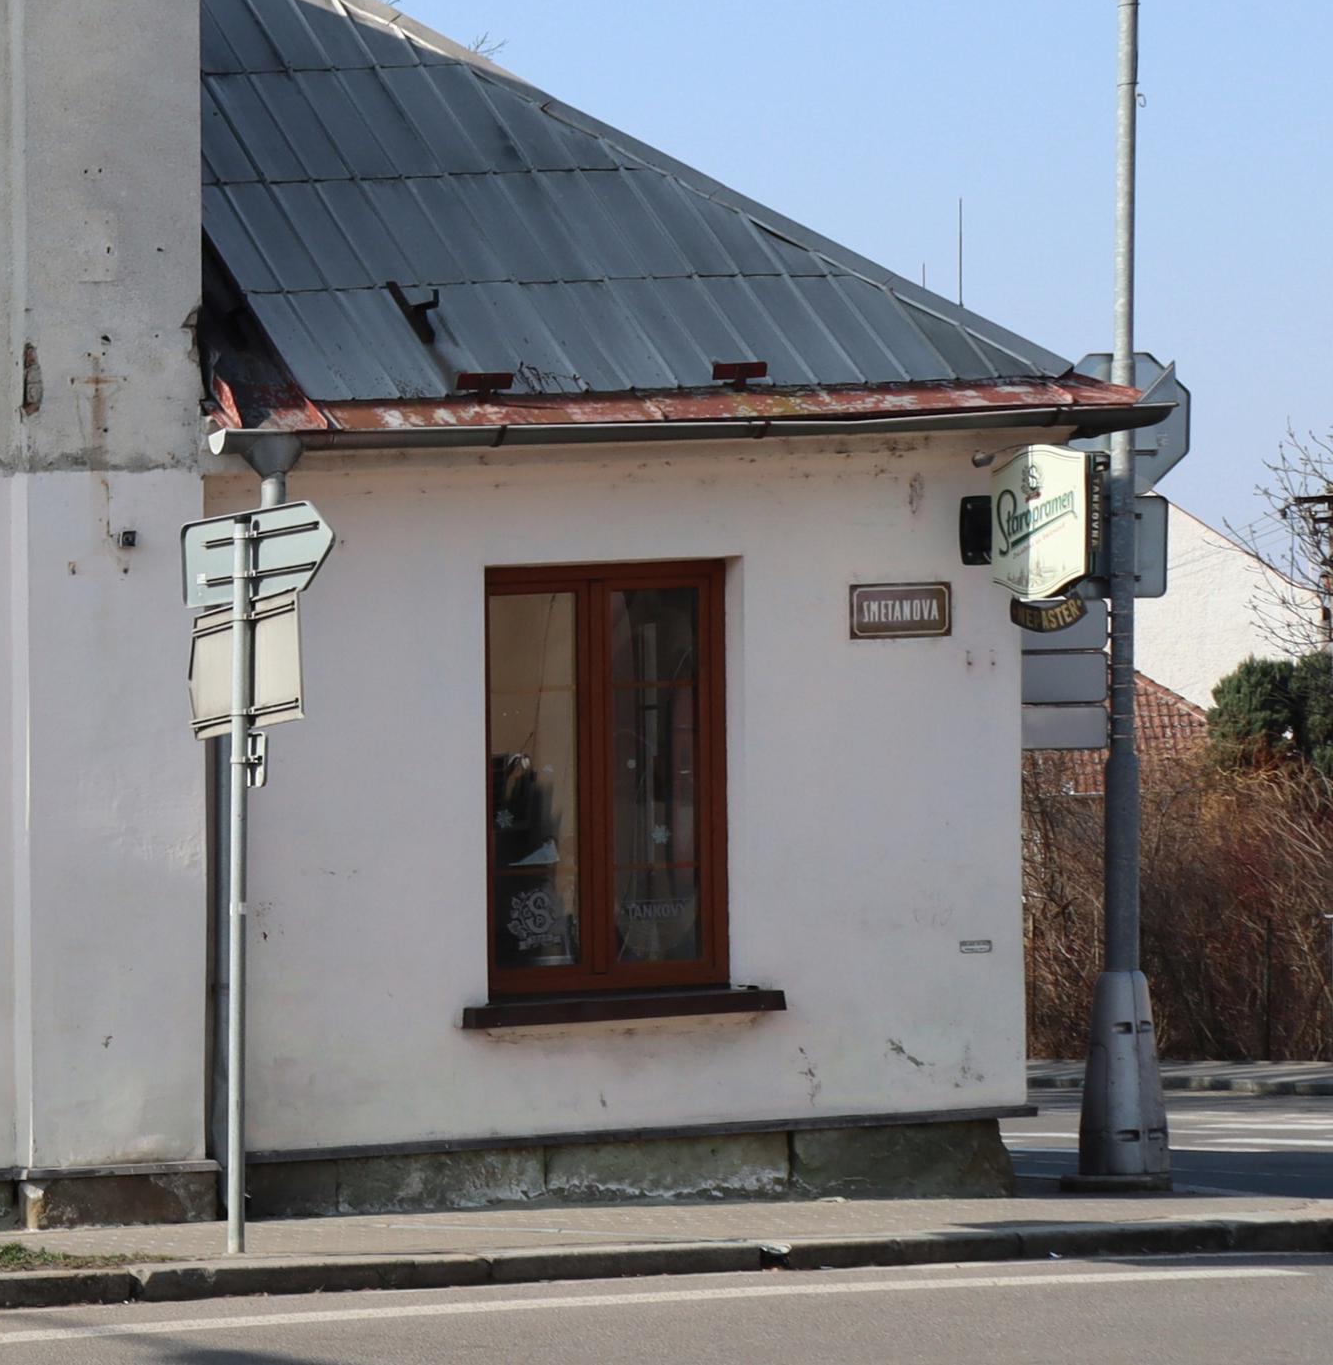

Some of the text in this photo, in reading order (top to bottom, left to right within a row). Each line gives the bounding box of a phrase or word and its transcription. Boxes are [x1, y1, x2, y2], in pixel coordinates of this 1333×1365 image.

[996, 488, 1078, 556] Staropramen
[1091, 477, 1101, 548] TANKOVNA
[862, 598, 939, 623] SMETANOVA
